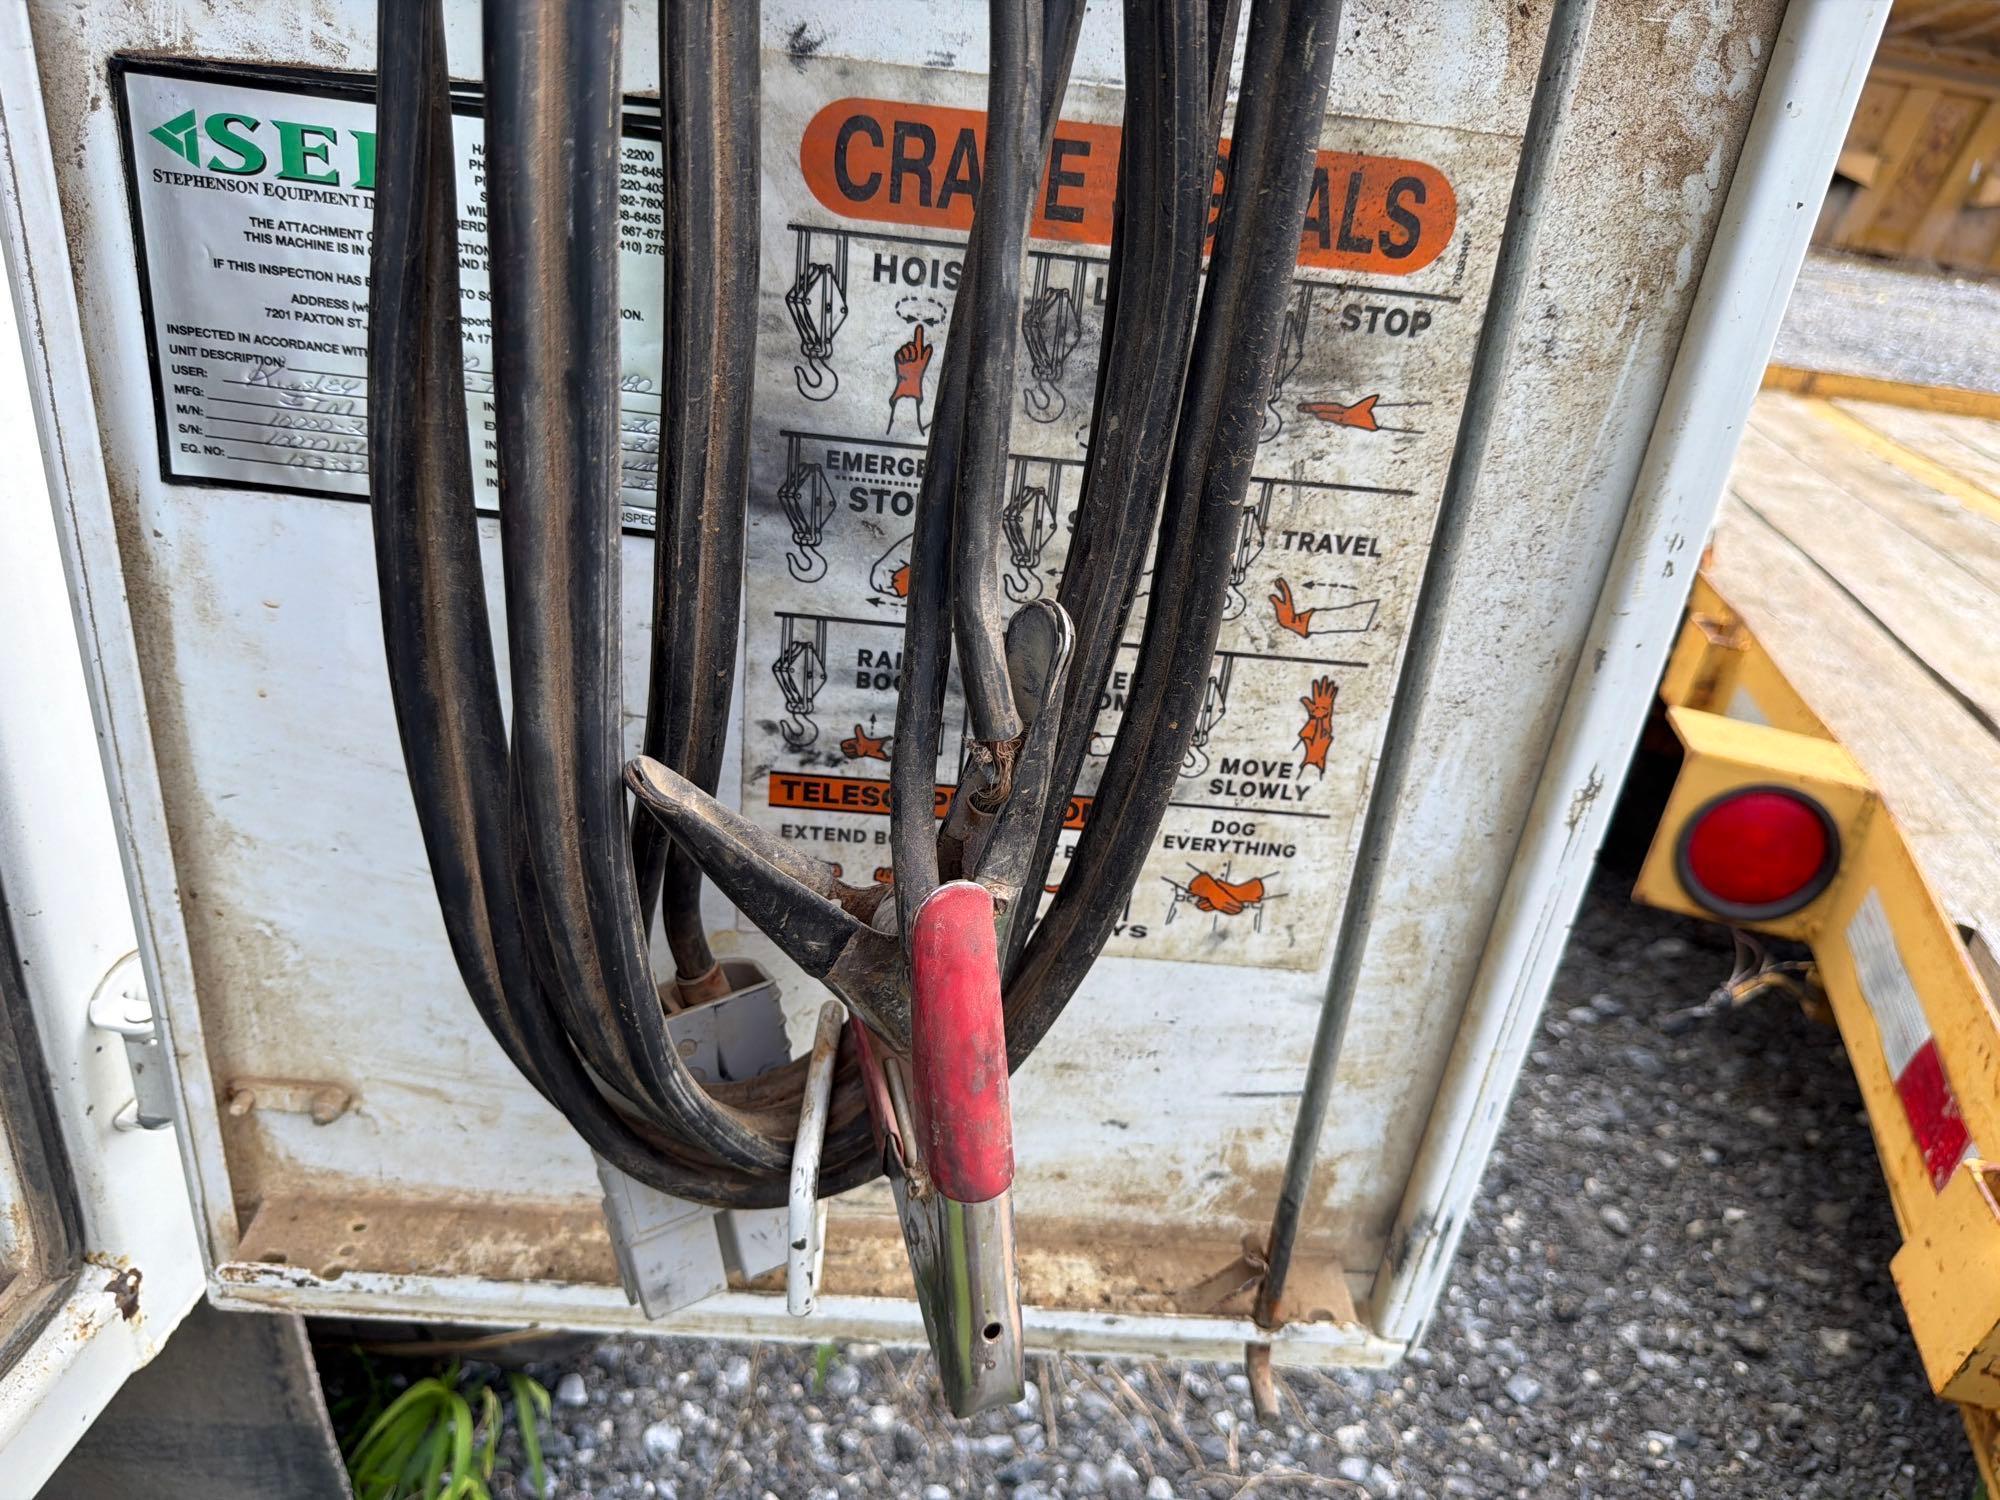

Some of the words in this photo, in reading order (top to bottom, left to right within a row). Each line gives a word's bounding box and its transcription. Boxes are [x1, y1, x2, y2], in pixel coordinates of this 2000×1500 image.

[622, 148, 654, 161] -2200
[834, 114, 1091, 223] CRAE
[153, 168, 259, 195] STEPHENSON
[262, 182, 360, 208] EQUIPMENT
[249, 216, 275, 230] THE
[276, 220, 364, 241] ATTACHMENT
[244, 231, 273, 244] THIS
[275, 234, 335, 252] MACHINE
[336, 241, 350, 254] IS
[351, 243, 365, 256] IN
[213, 258, 225, 269] IF
[227, 259, 257, 273] THIS
[258, 262, 335, 283] INSPECTION
[336, 272, 362, 287] HAS
[873, 253, 963, 291] HOIS
[291, 293, 350, 311] ADDRESS
[264, 307, 292, 320] 7201
[295, 311, 345, 328] PAXTON
[1341, 304, 1432, 337] STOP
[167, 323, 236, 342] INSPECTED
[238, 331, 251, 343] IN
[254, 333, 340, 353] ACCORDANCE
[169, 344, 198, 358] UNIT
[200, 347, 286, 368] DESCRIPTION:
[172, 365, 208, 378] USER:
[174, 385, 205, 397] MFG:
[176, 404, 204, 417] M/N:
[179, 423, 203, 436] S/N:
[181, 444, 202, 455] EQ.
[204, 445, 225, 457] NO:
[848, 486, 920, 516] STO
[1281, 531, 1382, 558] TRAVEL
[858, 648, 902, 670] RAI
[1219, 758, 1294, 779] MOVE
[1209, 778, 1311, 801] SLOWLY
[781, 824, 867, 844] EXTEND
[1211, 820, 1256, 836] DOG
[1163, 835, 1297, 858] EVERYTHING
